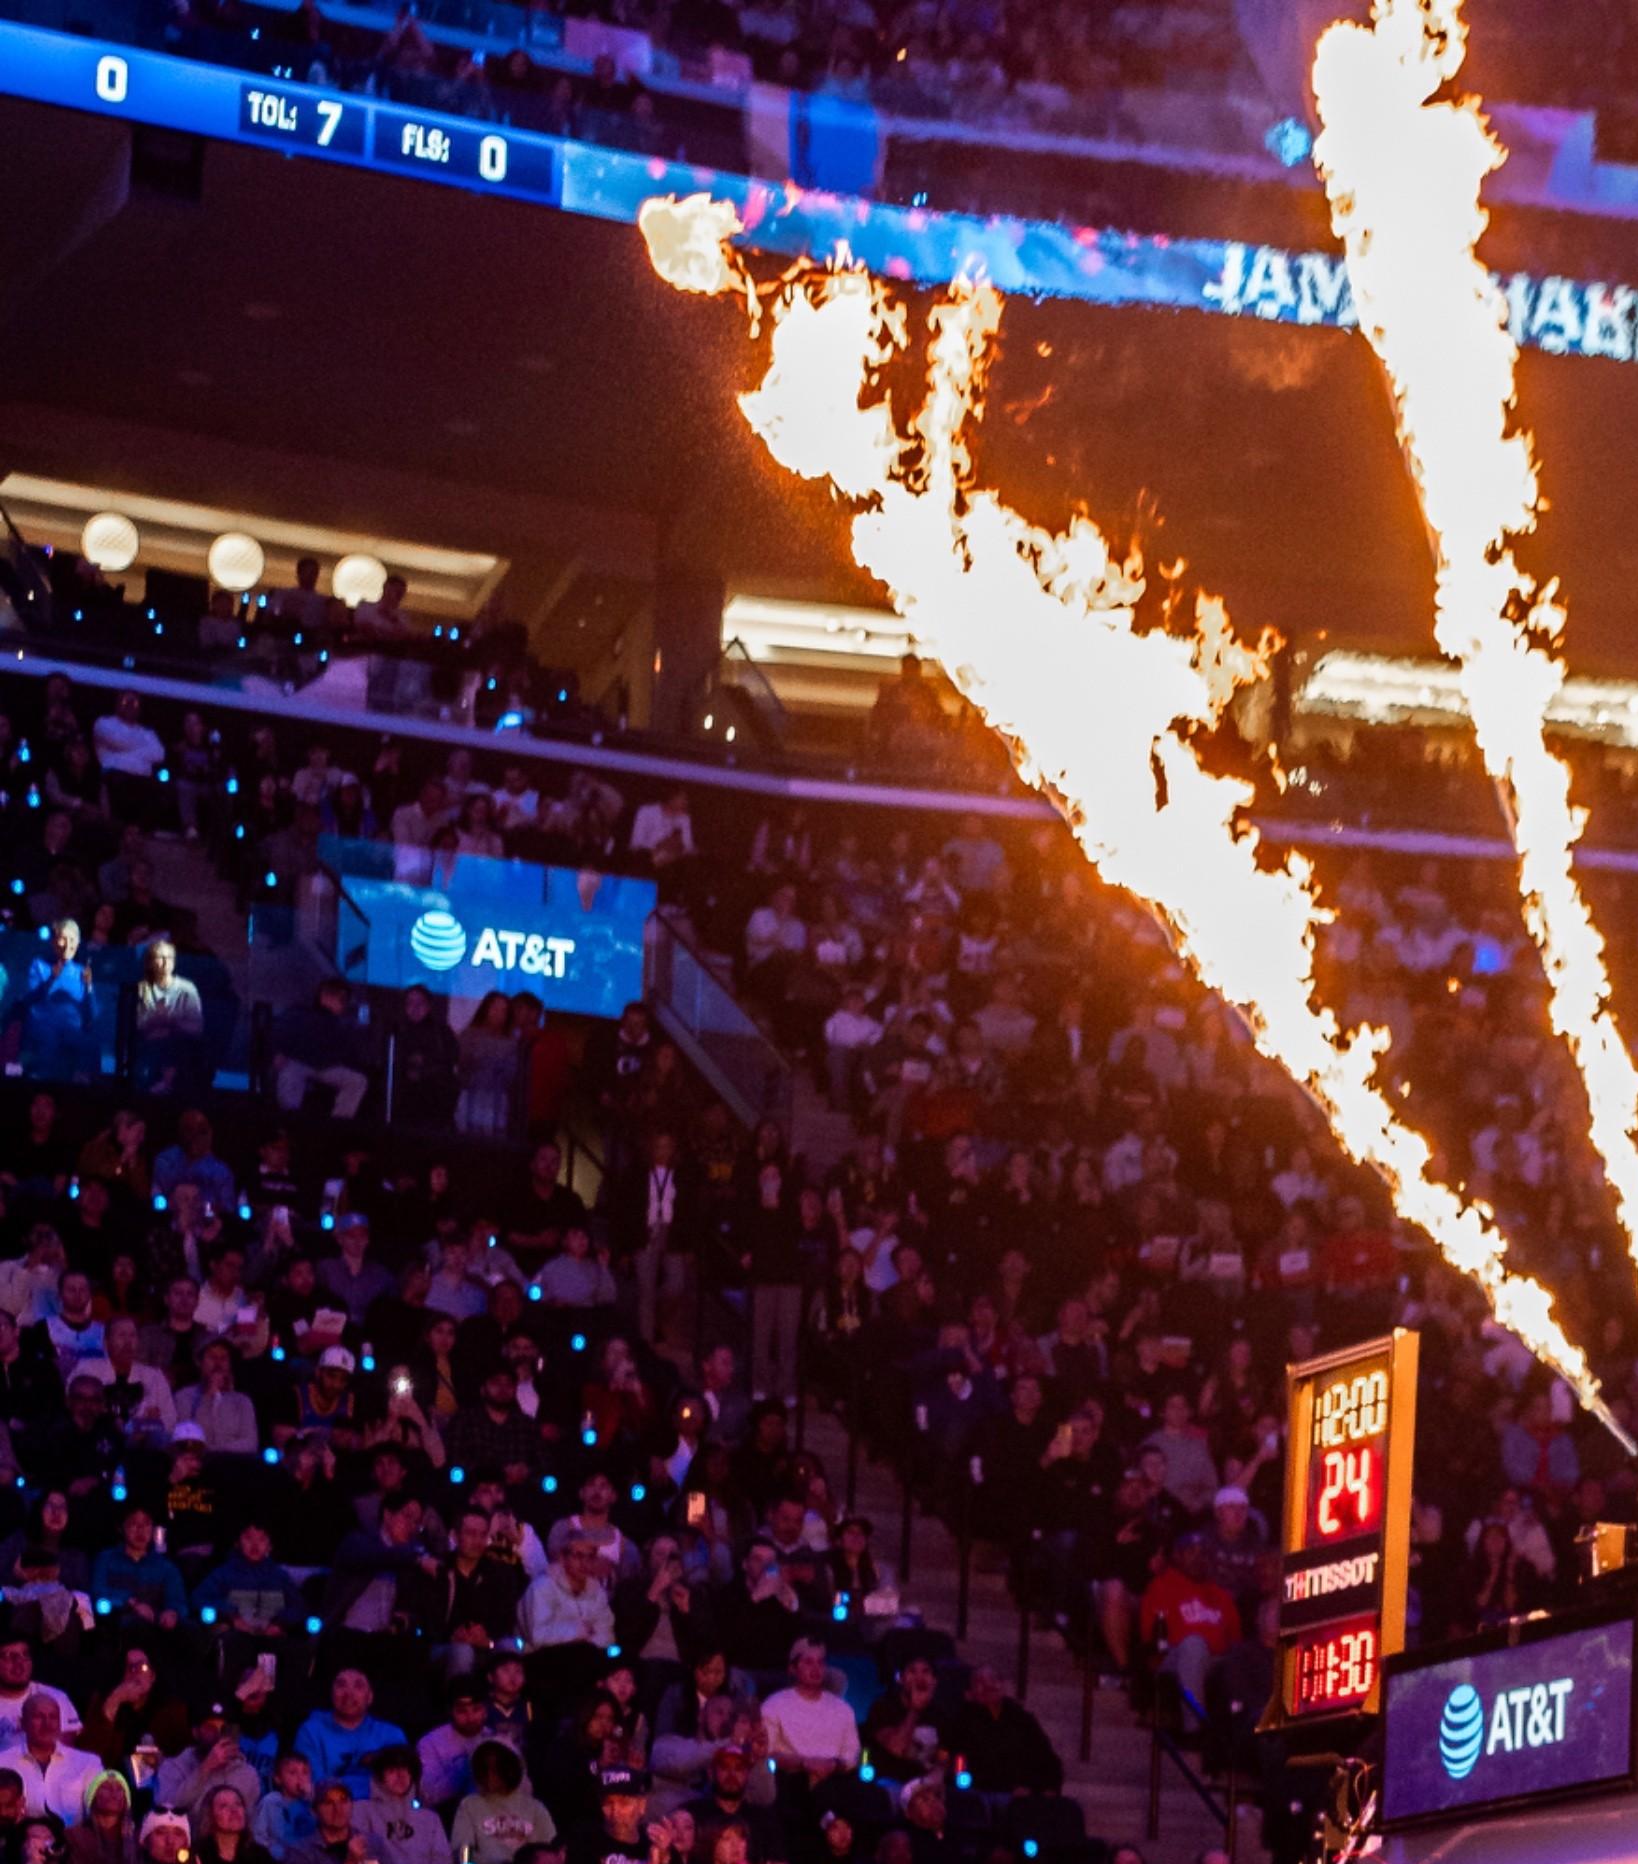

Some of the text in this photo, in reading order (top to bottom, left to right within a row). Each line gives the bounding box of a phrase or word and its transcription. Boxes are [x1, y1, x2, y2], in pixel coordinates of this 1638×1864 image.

[96, 56, 128, 102] 0
[248, 91, 342, 145] TOL: 7
[402, 123, 507, 181] FLS: 0
[472, 928, 574, 977] AT&T
[1318, 1448, 1371, 1534] 24
[1306, 1552, 1379, 1598] TISSOT
[1487, 1679, 1573, 1756] AT&T
